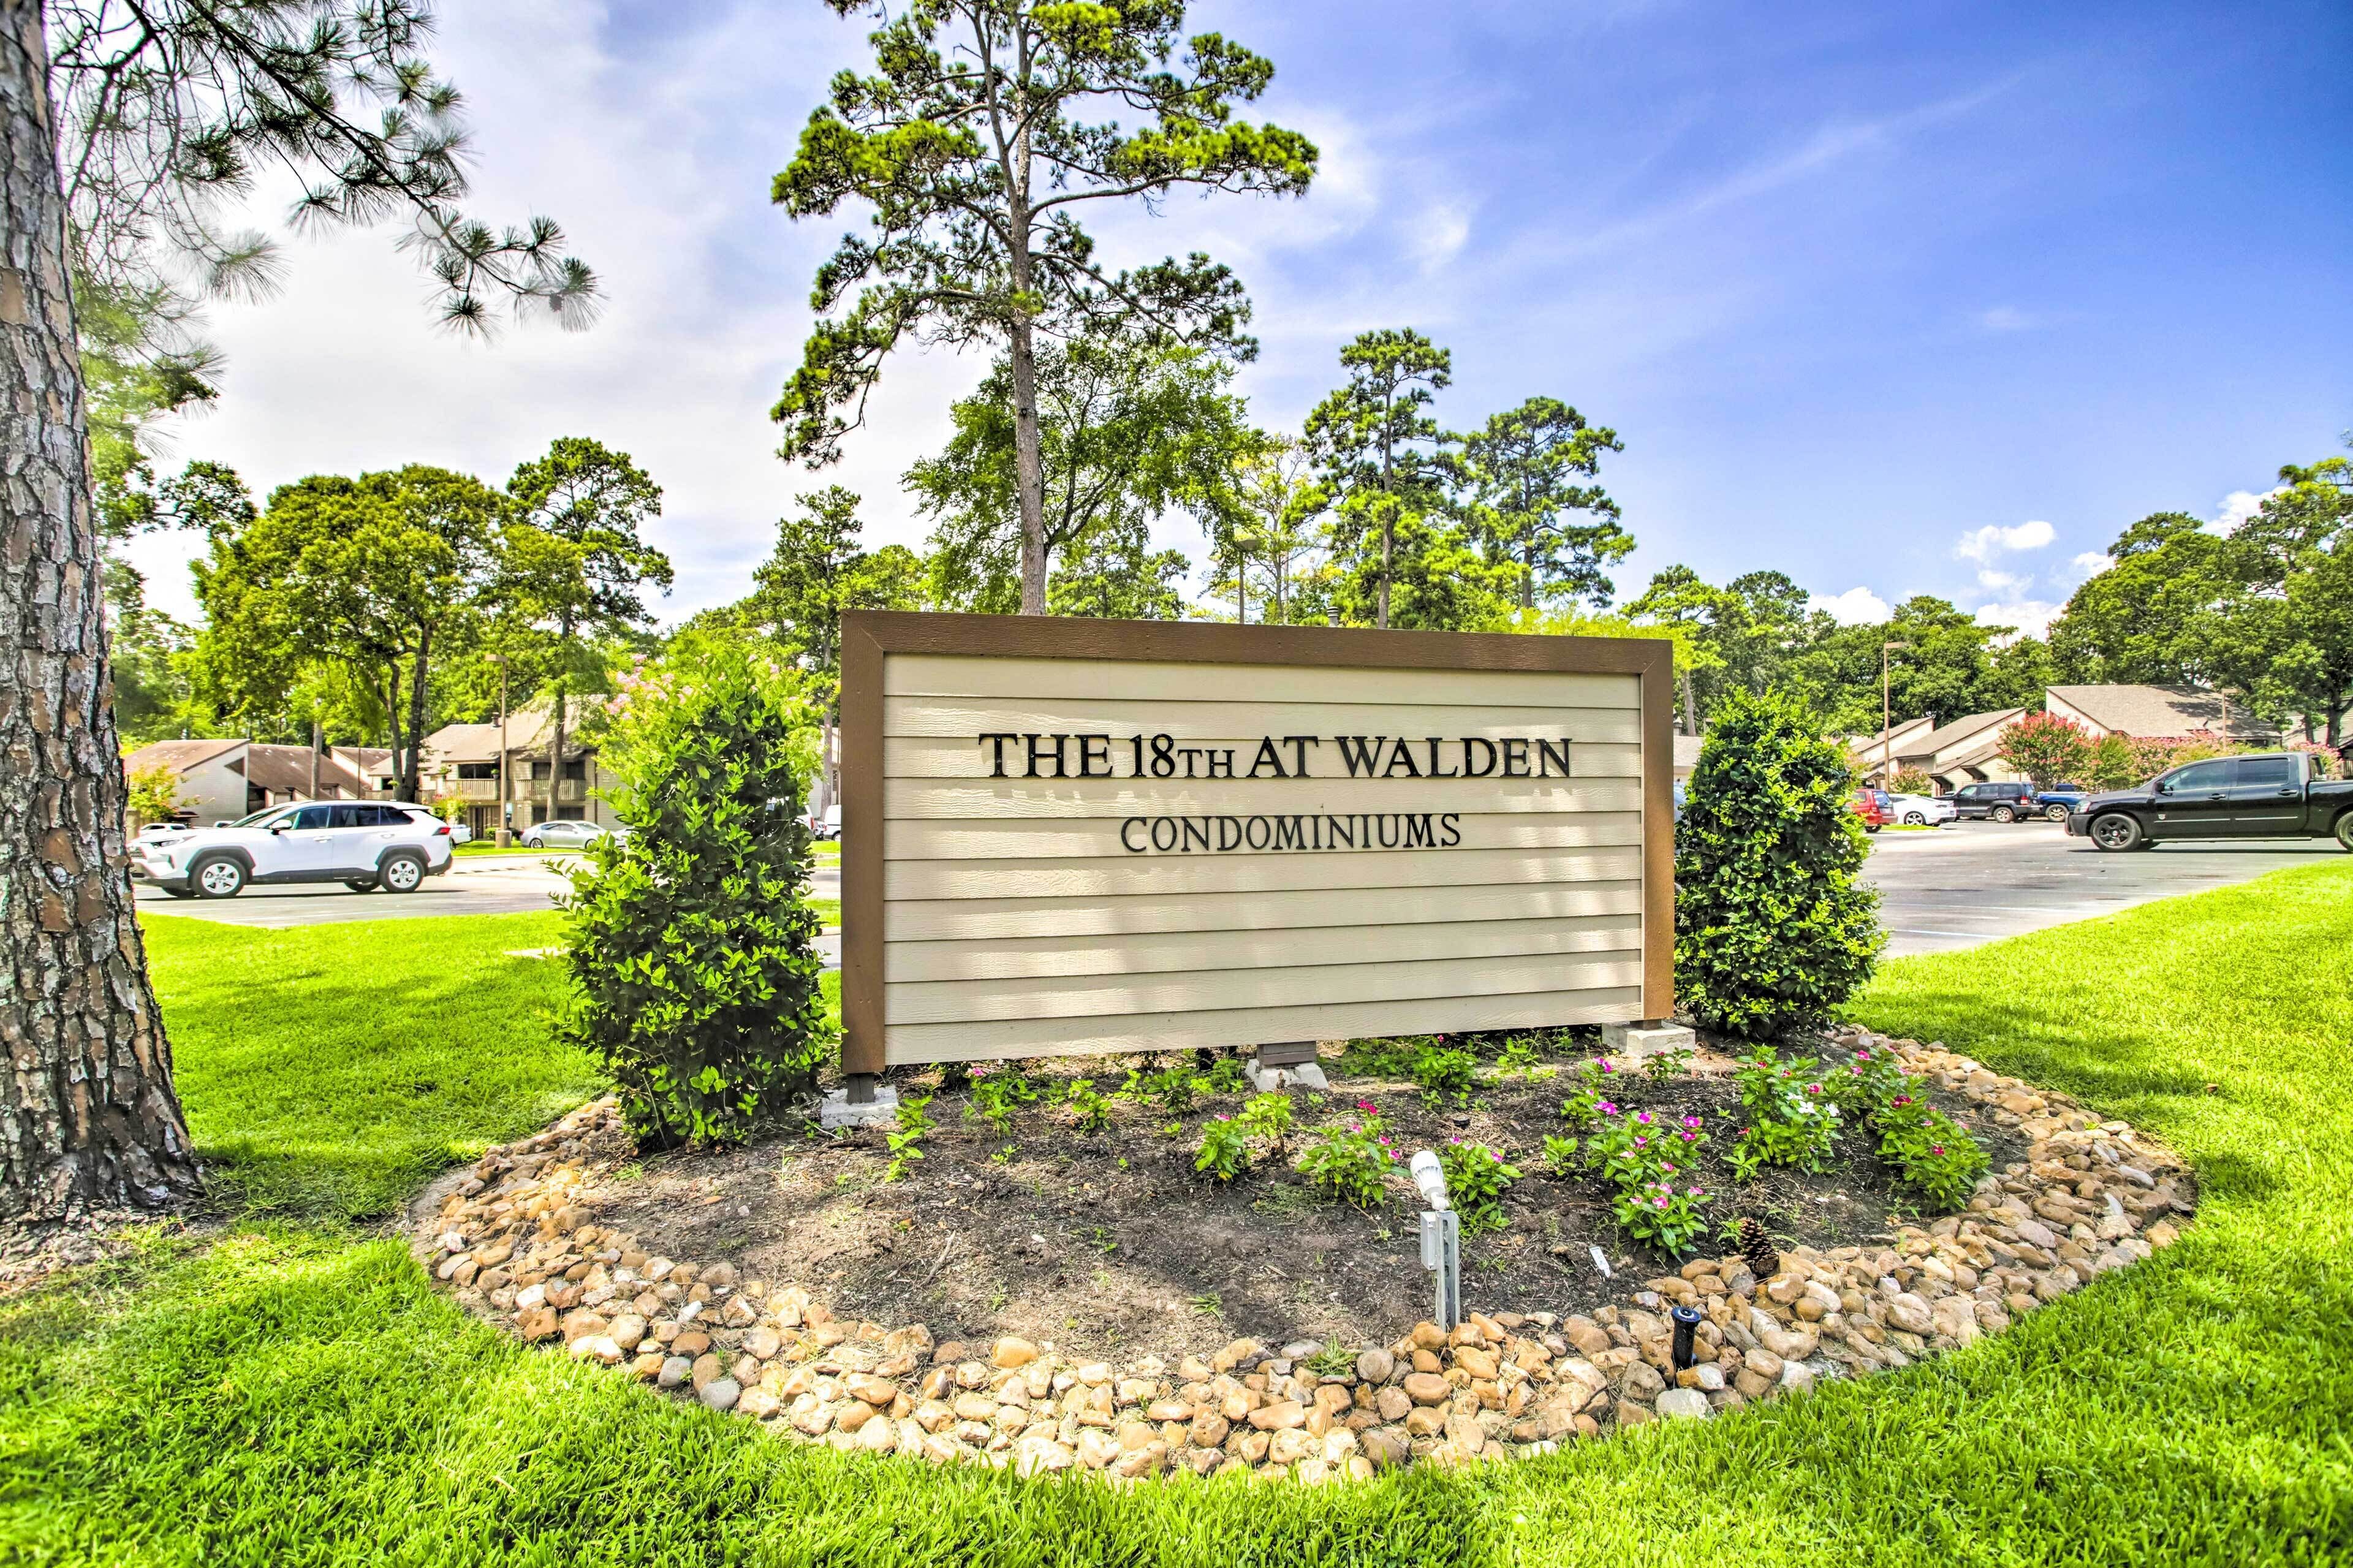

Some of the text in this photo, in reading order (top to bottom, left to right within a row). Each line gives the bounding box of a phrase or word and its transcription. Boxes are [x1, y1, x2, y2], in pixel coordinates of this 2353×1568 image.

[978, 733, 1572, 779] THE 18TH AT WALDEN
[1121, 812, 1461, 852] CONDOMINIUMS
